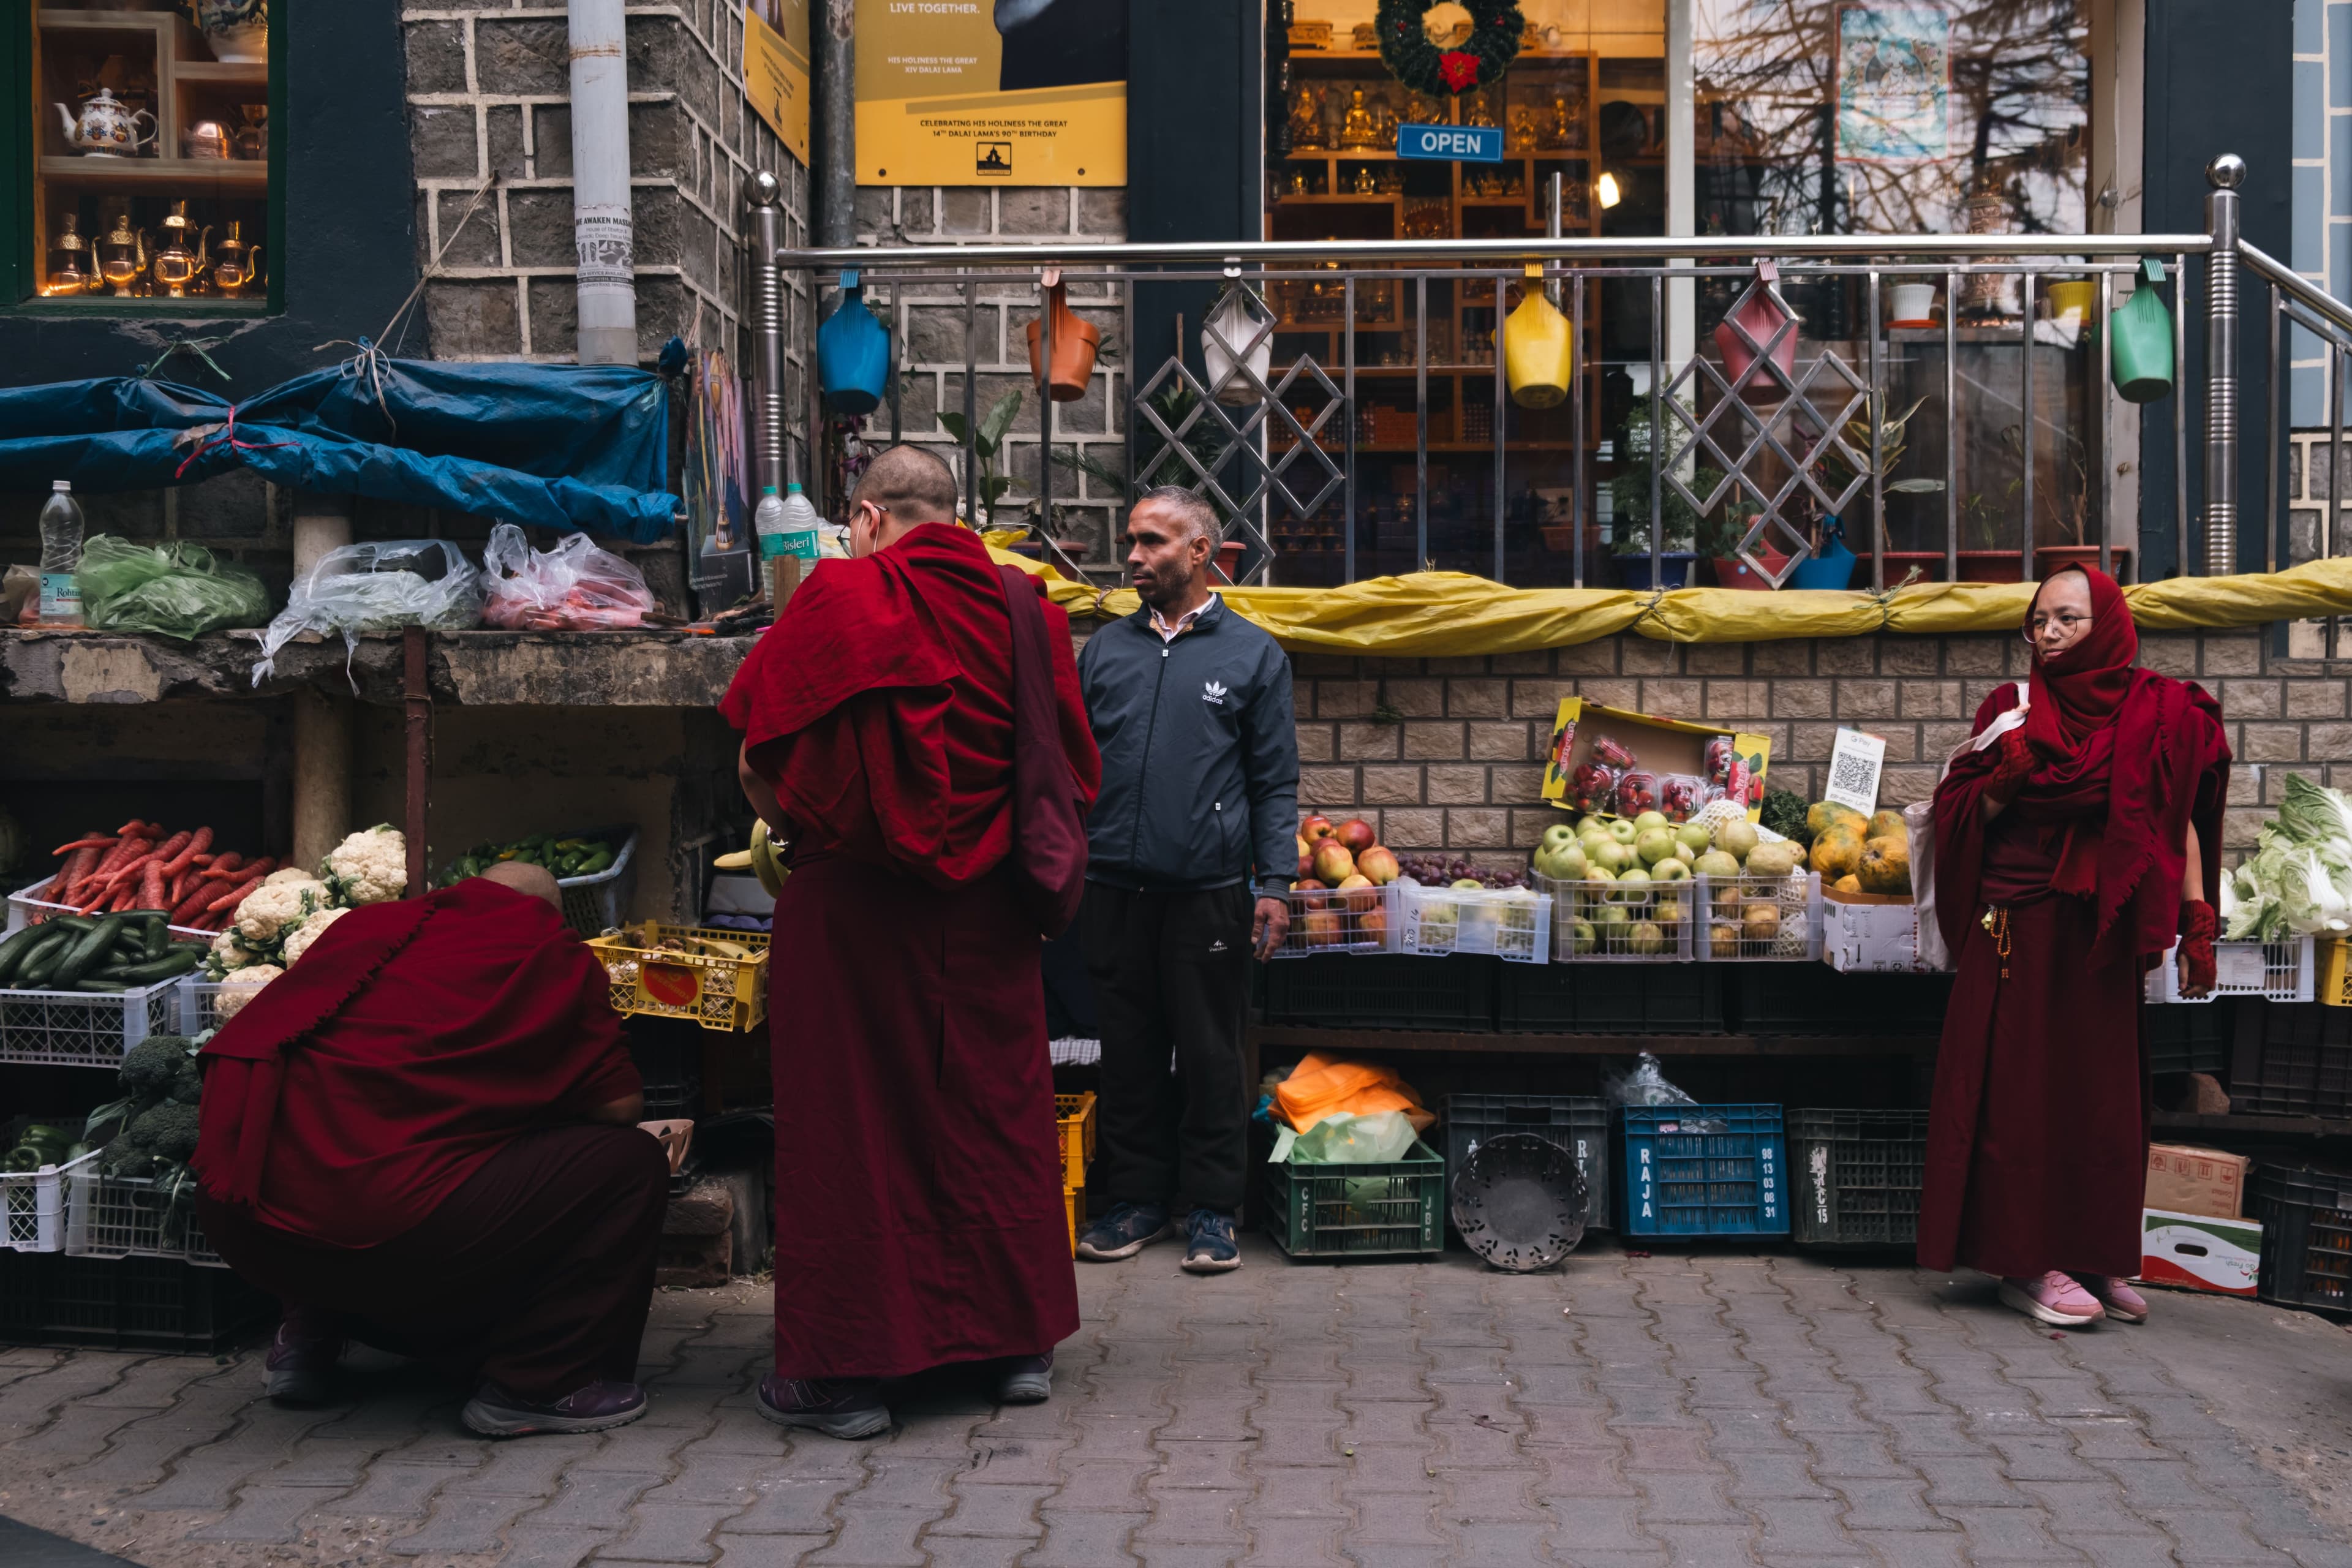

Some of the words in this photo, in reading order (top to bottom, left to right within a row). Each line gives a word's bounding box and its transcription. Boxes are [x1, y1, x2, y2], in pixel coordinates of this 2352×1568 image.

[890, 2, 915, 13] LIVE
[918, 3, 980, 13] TOGETHER.
[1421, 132, 1481, 154] OPEN
[584, 216, 611, 225] AWAKEN
[783, 537, 809, 551] Bisleri
[1202, 695, 1223, 705] adidas
[1858, 738, 1872, 747] Pay
[1762, 1148, 1773, 1160] 98
[1763, 1163, 1773, 1174] 13
[1640, 1148, 1652, 1218] RAJA
[1763, 1177, 1774, 1189] 03
[1764, 1192, 1775, 1203] 08
[1765, 1207, 1775, 1218] 31
[1817, 1208, 1828, 1223] 15
[2226, 1260, 2244, 1269] Fresh
